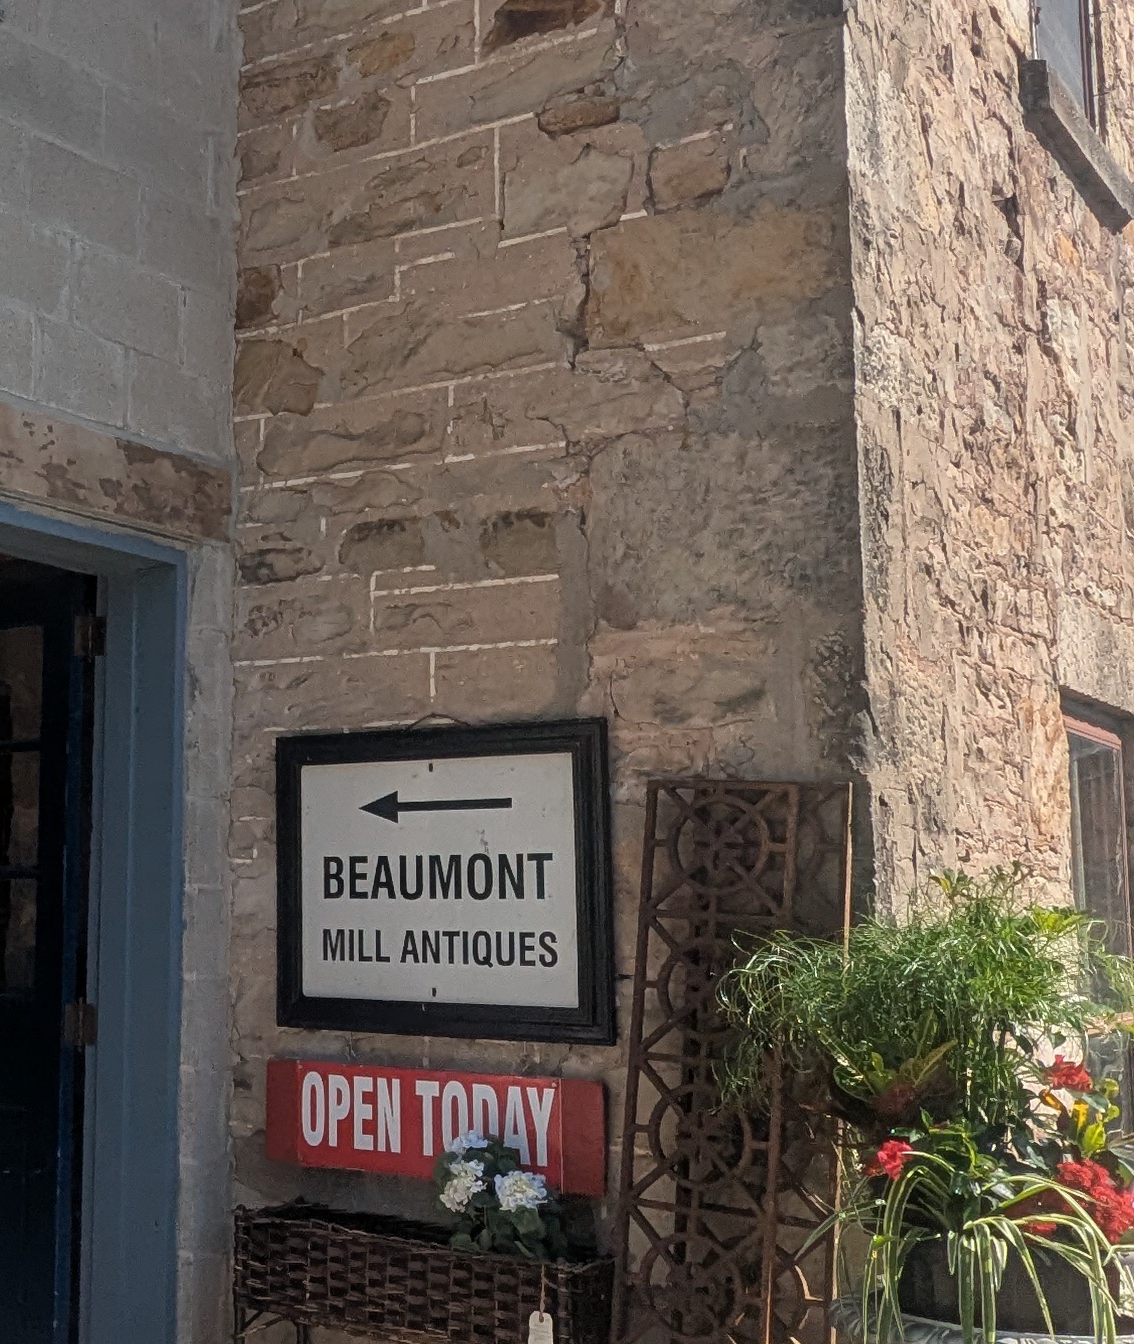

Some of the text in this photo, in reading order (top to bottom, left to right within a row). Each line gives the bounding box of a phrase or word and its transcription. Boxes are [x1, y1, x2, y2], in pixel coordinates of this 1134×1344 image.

[323, 853, 553, 901] BEAUMONT
[322, 928, 558, 968] MILL ANTIQUES
[302, 1071, 555, 1167] OPEN TODAY
